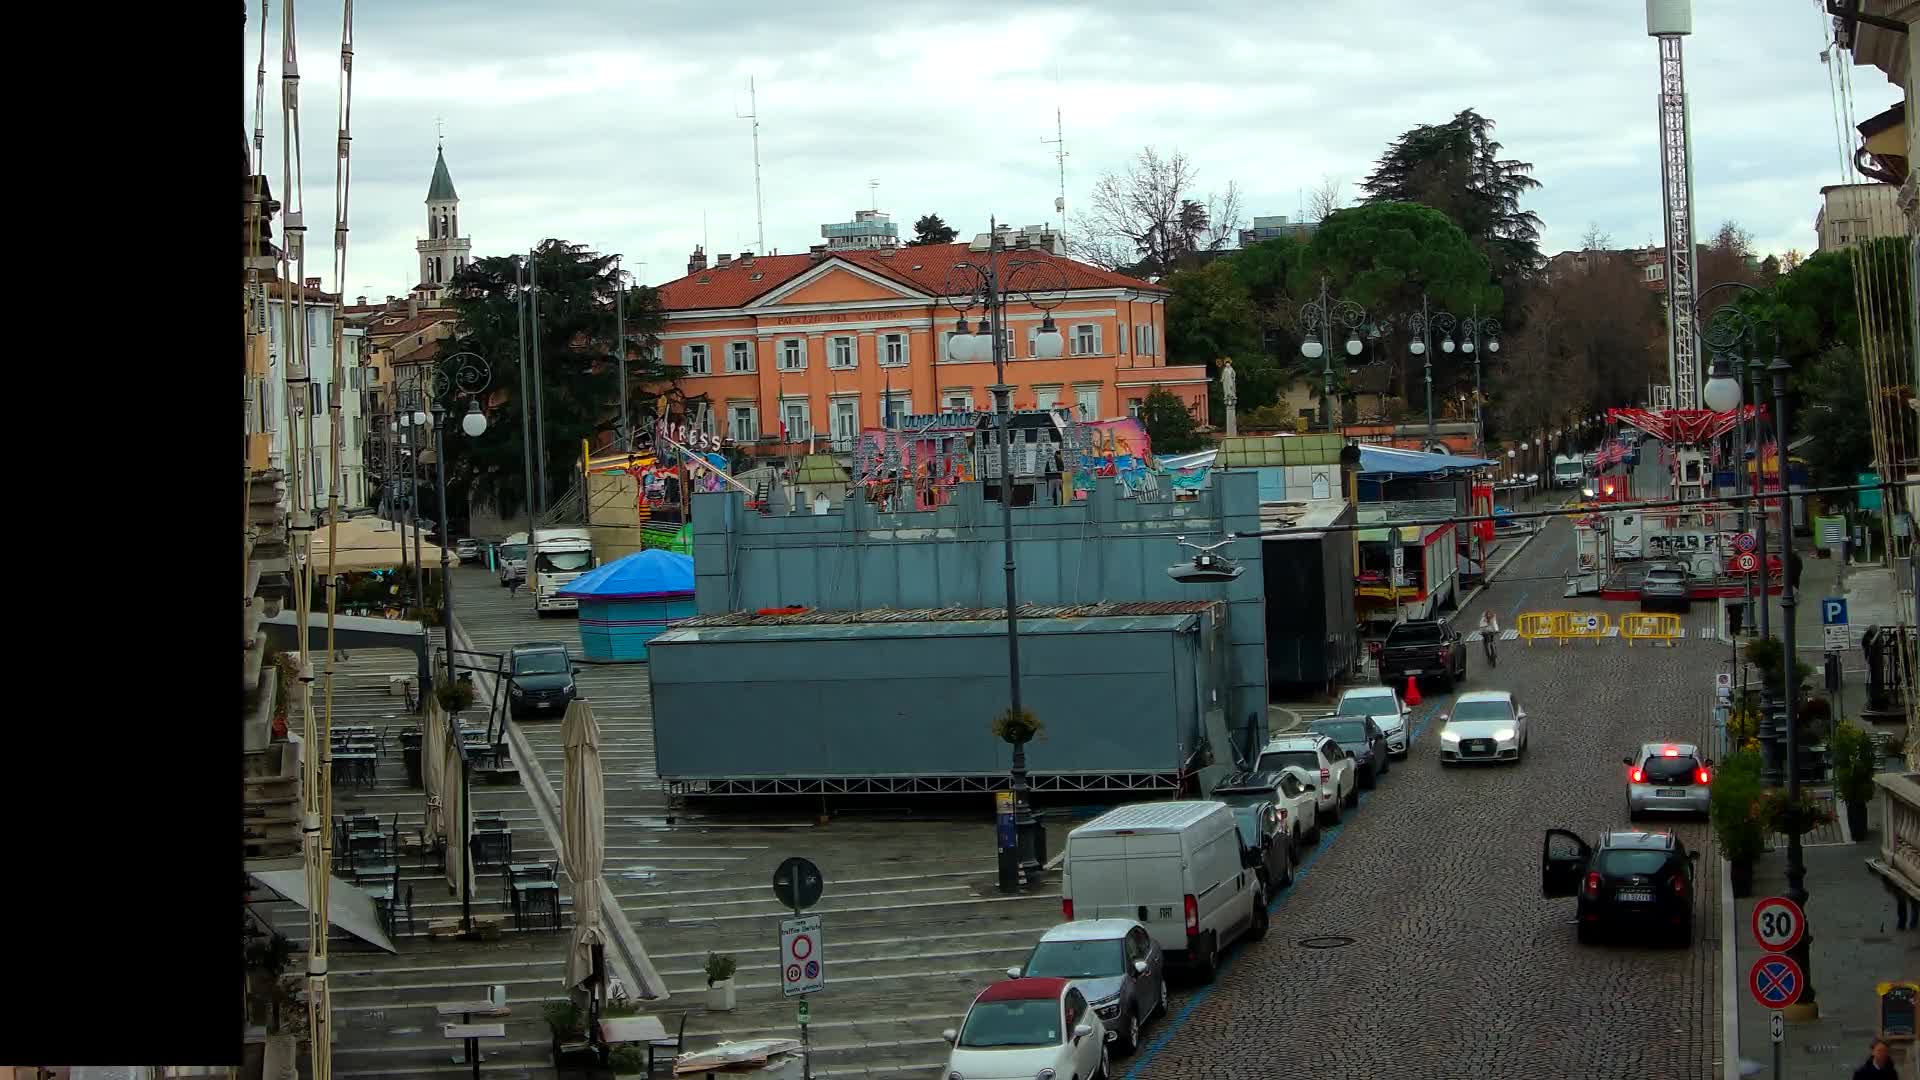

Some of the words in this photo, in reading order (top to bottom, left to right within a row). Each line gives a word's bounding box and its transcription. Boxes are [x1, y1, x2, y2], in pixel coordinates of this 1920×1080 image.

[1742, 557, 1753, 567] 20
[1827, 602, 1841, 622] P
[1762, 912, 1791, 937] 30
